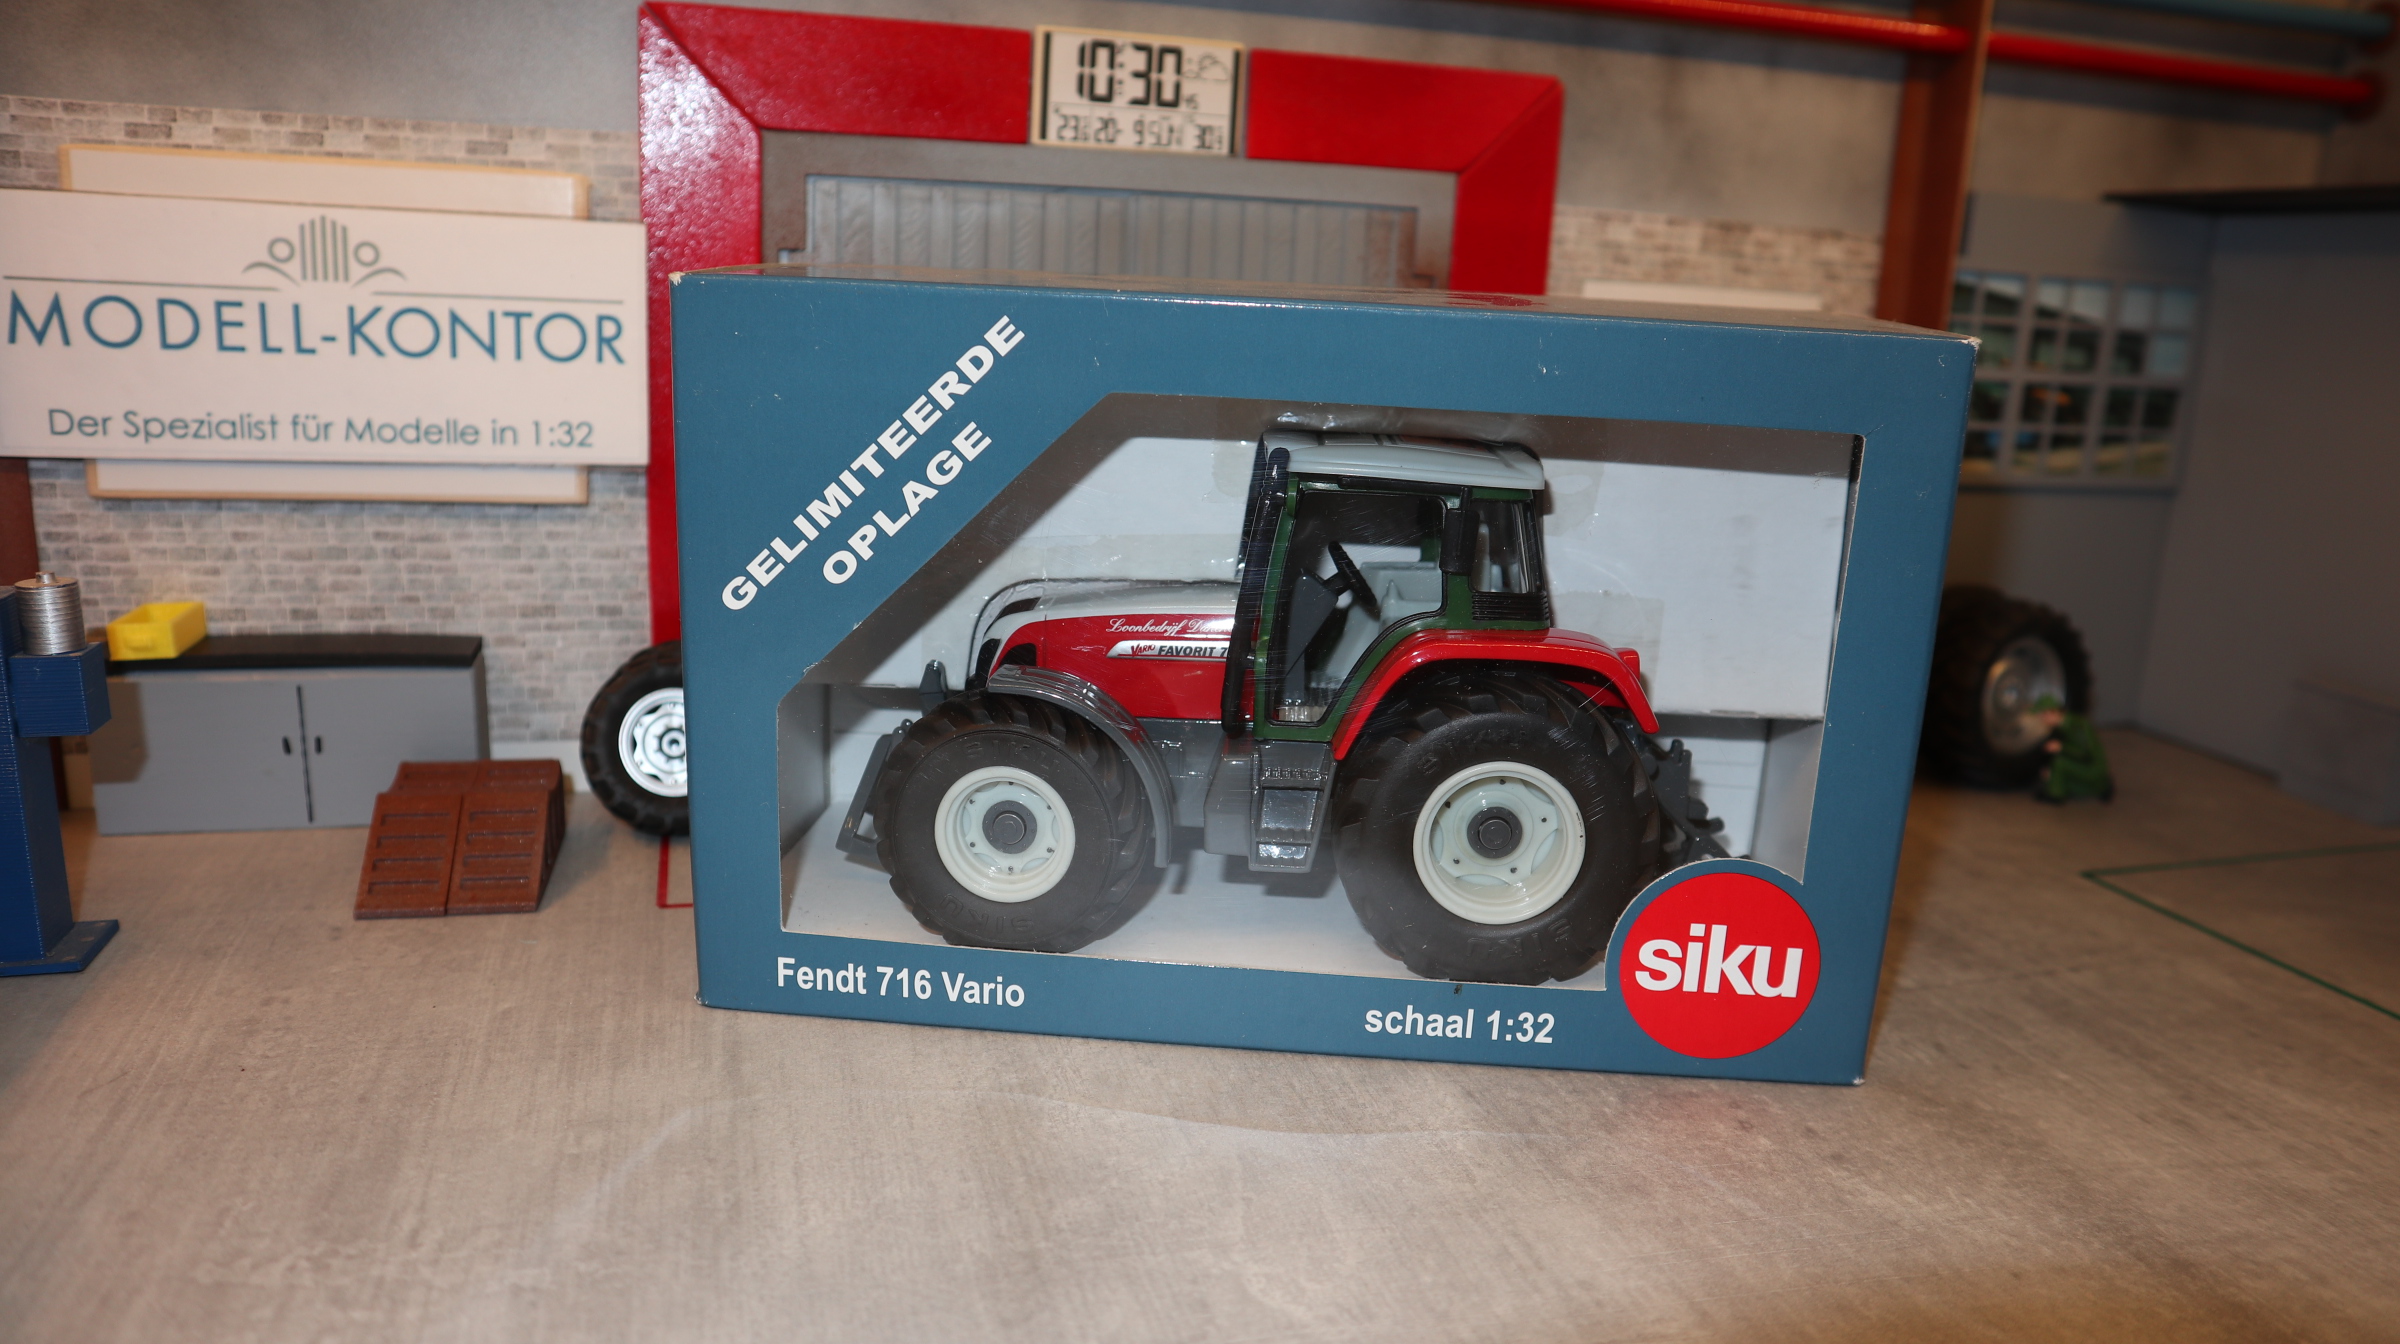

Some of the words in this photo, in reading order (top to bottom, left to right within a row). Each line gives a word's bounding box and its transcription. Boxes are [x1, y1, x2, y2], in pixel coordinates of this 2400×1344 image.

[1077, 39, 1182, 107] 10:30
[7, 289, 626, 364] MODELL-KONTOR
[48, 408, 112, 437] Der
[122, 410, 279, 443] Spezialist
[290, 413, 334, 442] für
[344, 416, 480, 445] Modelle
[490, 418, 519, 446] in
[531, 419, 595, 448] 1:32
[721, 315, 1026, 611] GELIMITEERDE
[822, 421, 993, 585] OPLAGE
[1105, 618, 1187, 637] Loonbedrijf
[1157, 645, 1217, 658] FAVORIT
[777, 956, 867, 995] Fendt
[876, 965, 932, 1000] 716
[941, 971, 1025, 1008] Vario
[1635, 922, 1804, 998] siku
[1364, 1004, 1475, 1039] schaal
[1486, 1010, 1555, 1044] 1:32
